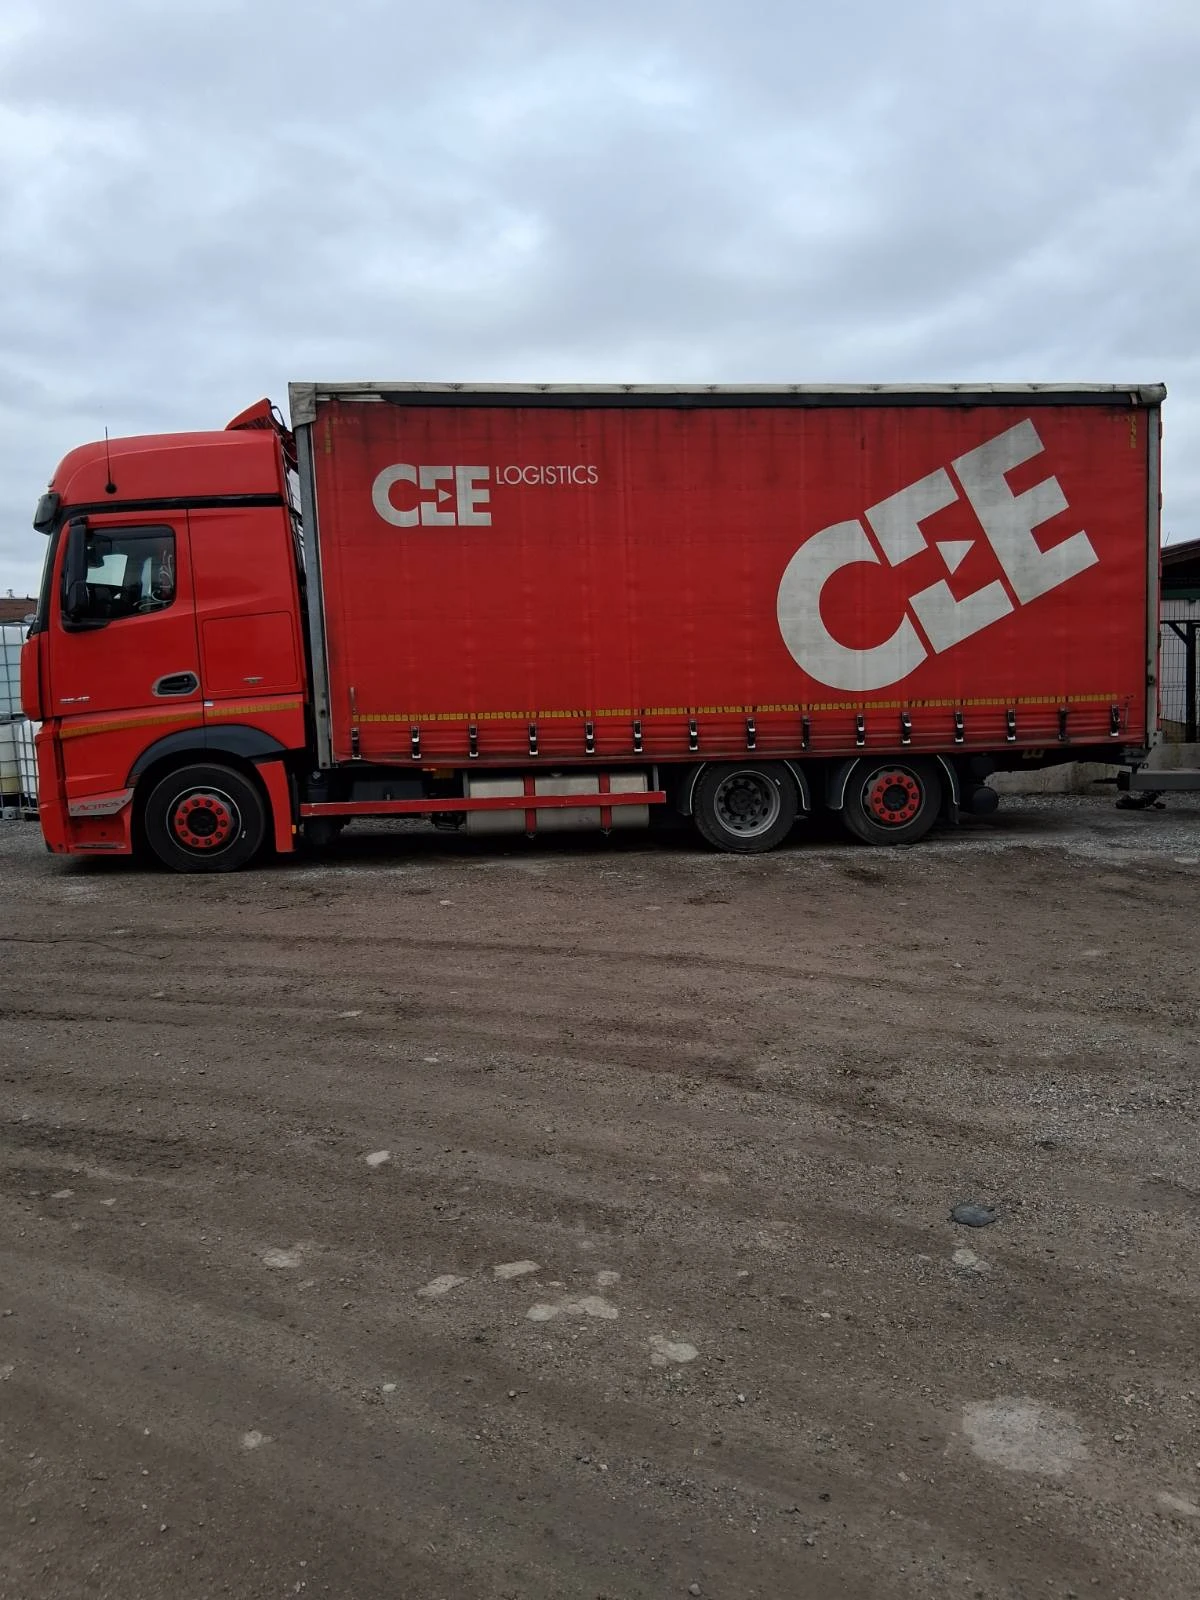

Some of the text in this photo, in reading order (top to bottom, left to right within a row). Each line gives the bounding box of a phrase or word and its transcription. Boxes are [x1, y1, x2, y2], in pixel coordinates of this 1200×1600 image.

[371, 463, 598, 527] CEE LOGISTICS
[777, 418, 1100, 691] CEE
